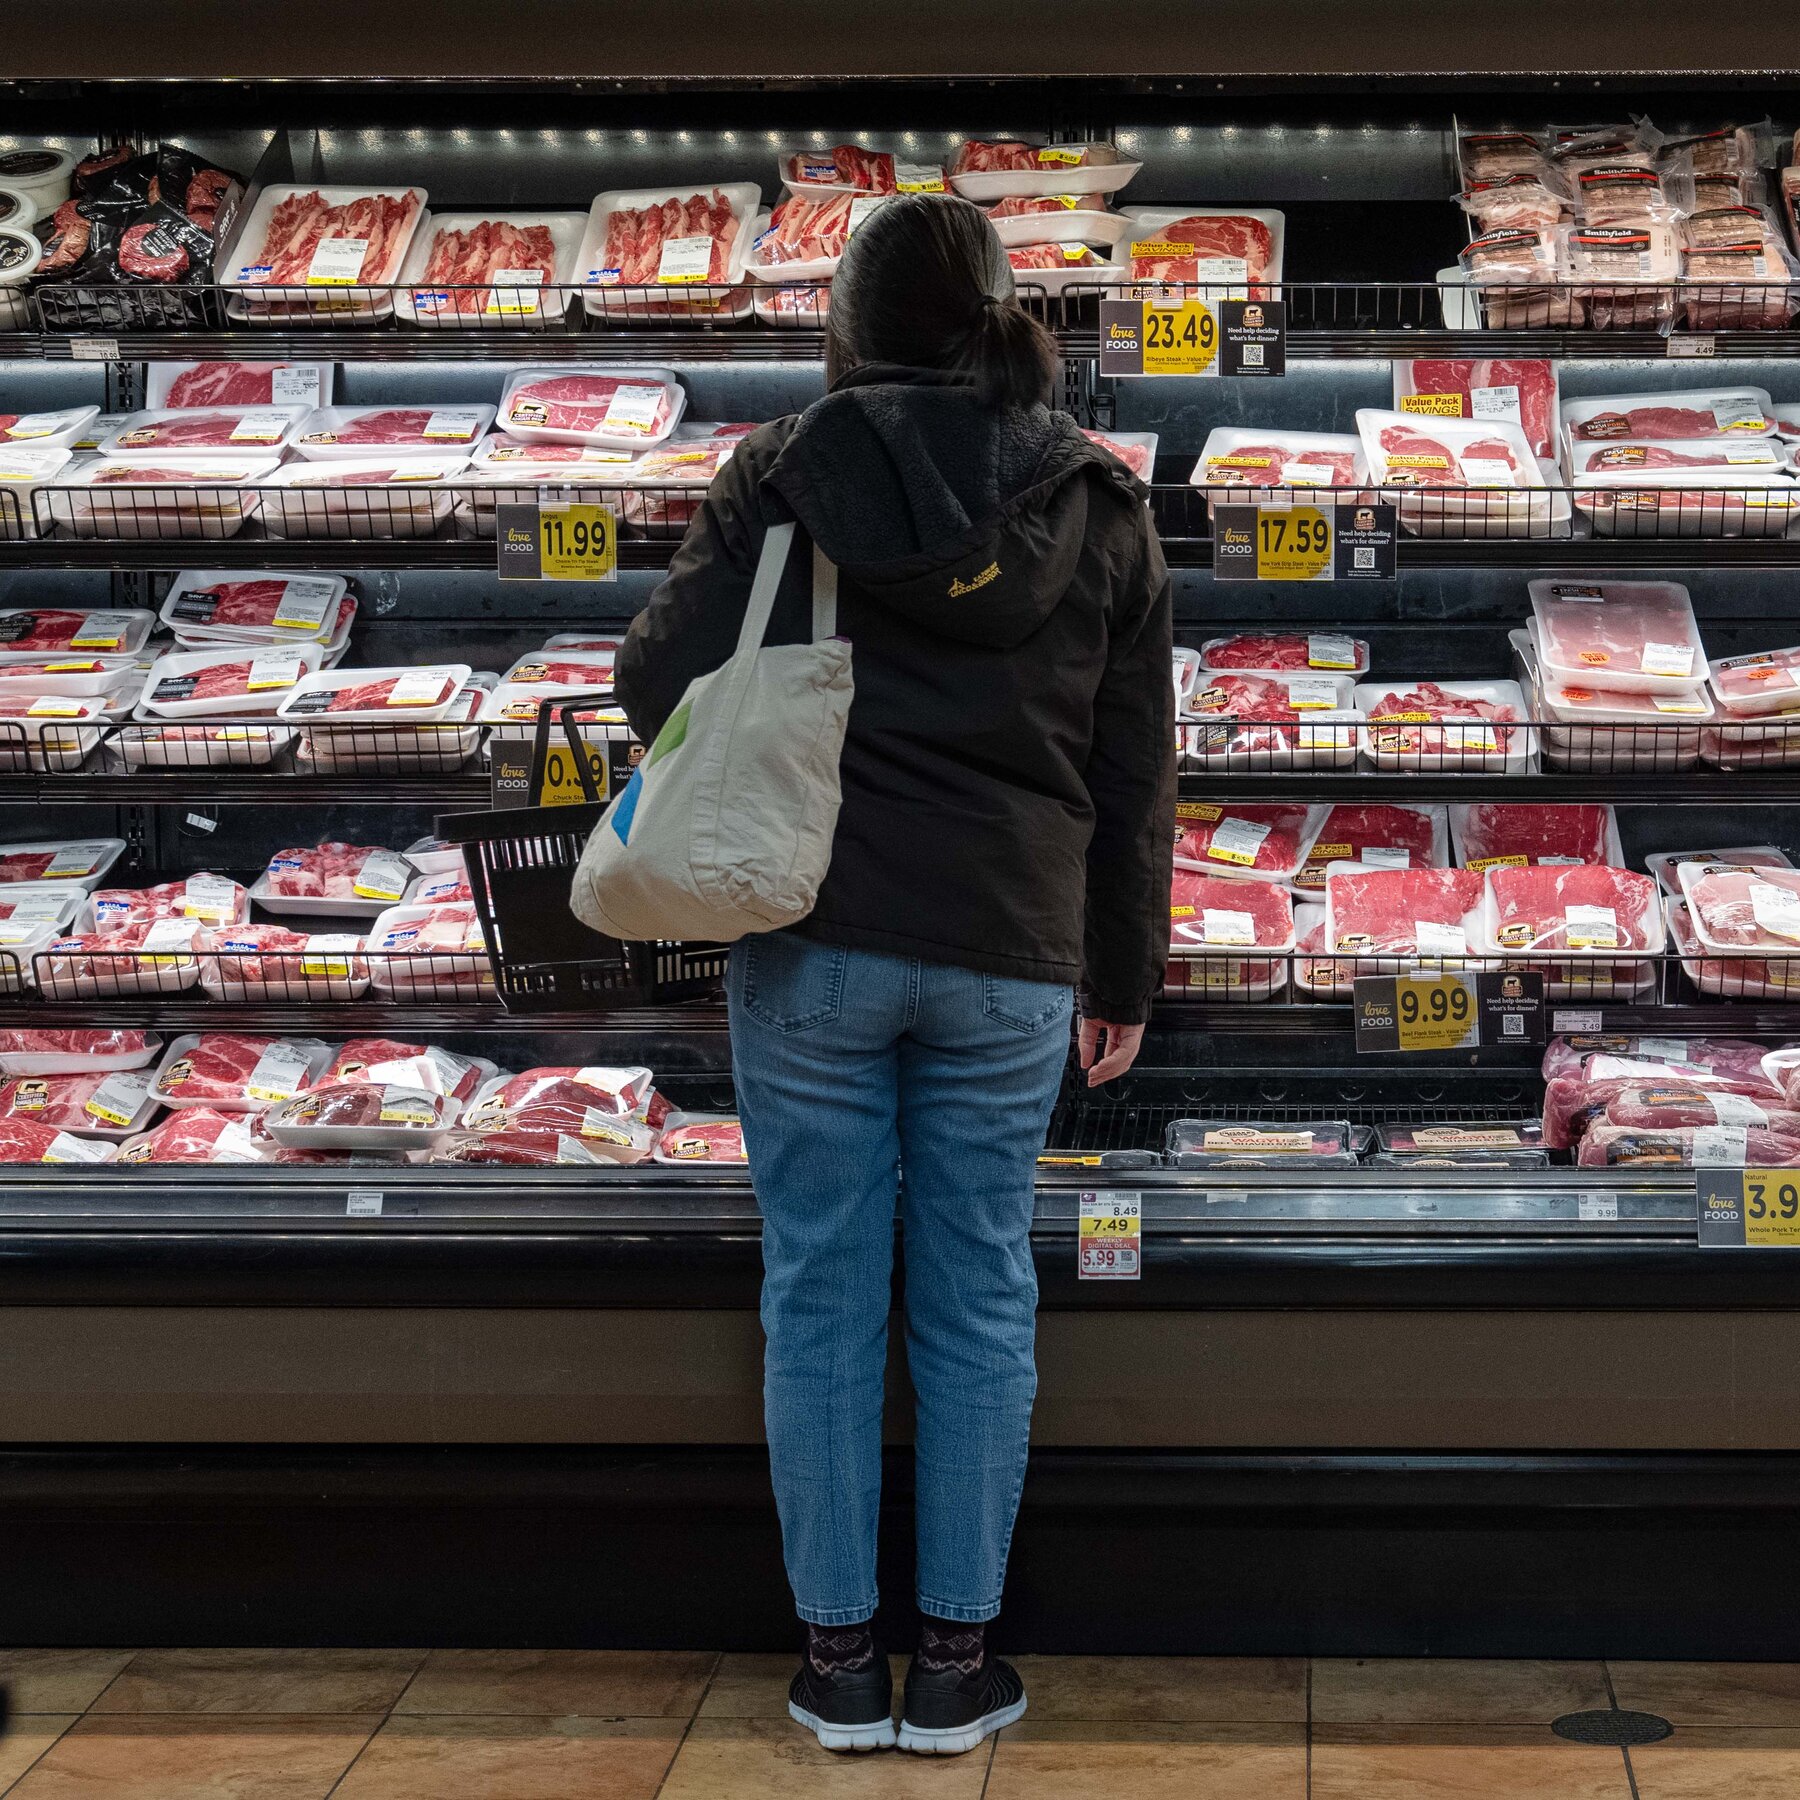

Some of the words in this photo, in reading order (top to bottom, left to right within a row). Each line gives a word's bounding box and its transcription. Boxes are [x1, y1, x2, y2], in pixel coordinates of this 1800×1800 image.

[1584, 229, 1633, 238] Smithfield
[1111, 323, 1136, 338] love
[1147, 314, 1214, 348] 23.49
[1106, 341, 1138, 349] FOOD
[1405, 398, 1432, 406] Value
[1435, 397, 1459, 405] Pack
[1405, 405, 1459, 414] SAVINGS
[508, 528, 531, 542] love
[543, 521, 606, 556] 11.99
[1225, 528, 1250, 543] love
[1260, 519, 1328, 553] 17.59
[1354, 530, 1366, 538] help
[1367, 530, 1391, 538] deciding
[504, 543, 534, 551] FOOD
[1220, 545, 1252, 554] FOOD
[501, 762, 526, 778] love
[497, 780, 529, 788] FOOD
[1470, 860, 1498, 868] Value
[1365, 1001, 1390, 1016] love
[1401, 988, 1468, 1023] 9.99
[1361, 1018, 1393, 1026] FOOD
[1708, 1193, 1736, 1209] love
[1113, 1207, 1138, 1216] 8.49
[1597, 1209, 1617, 1217] 9.99
[1704, 1211, 1739, 1220] FOOD
[1093, 1219, 1128, 1231] 7.49
[1083, 1250, 1115, 1266] 5.99
